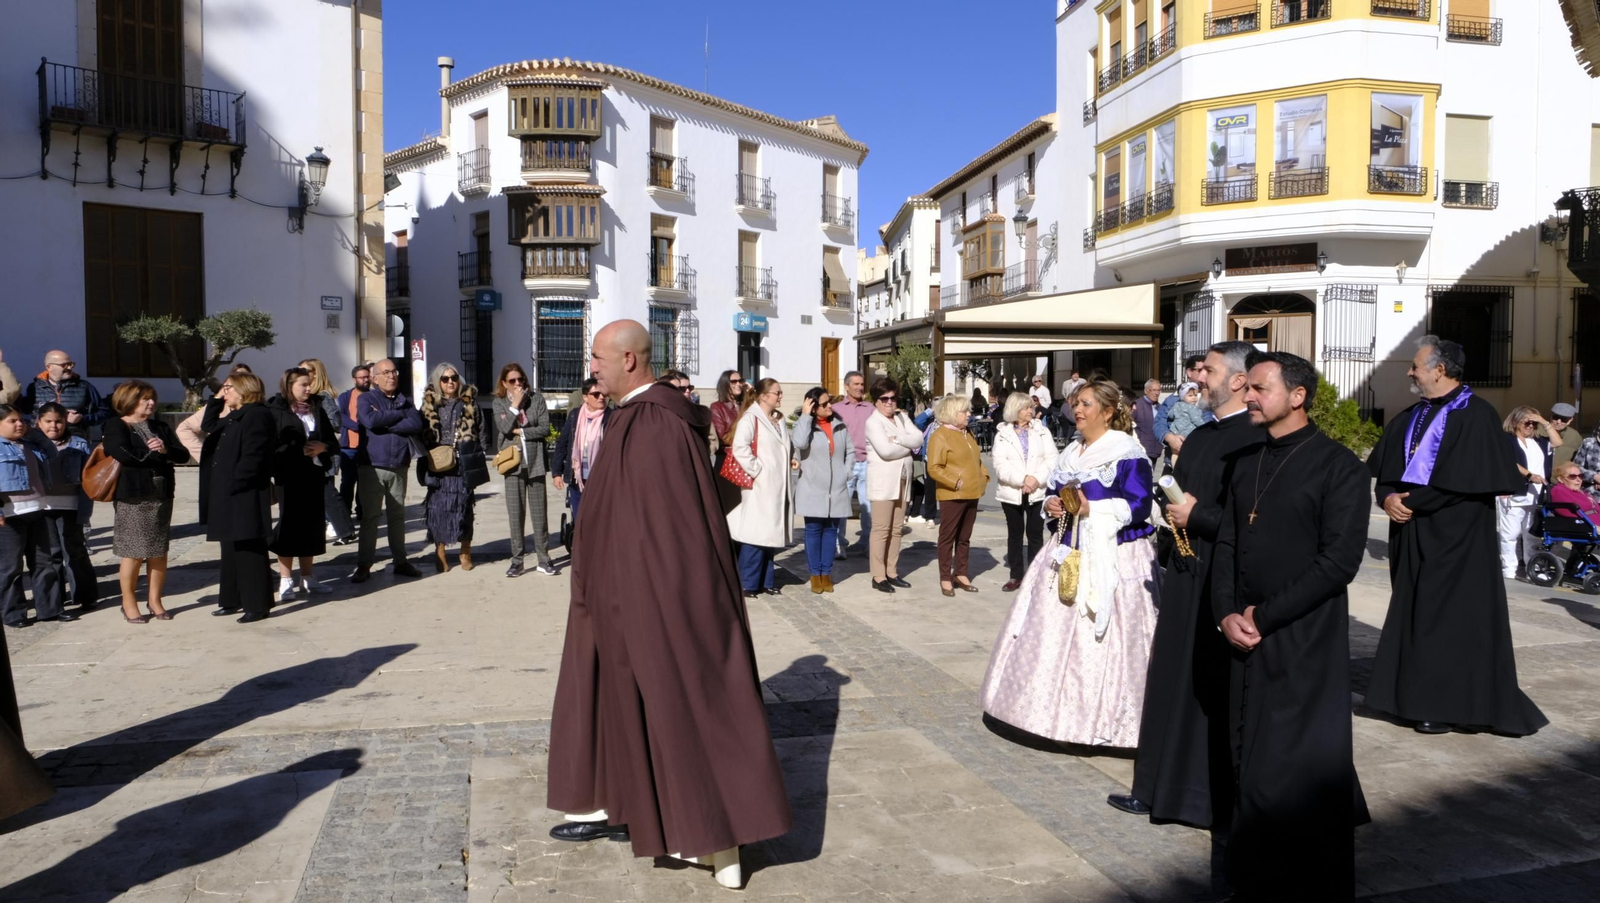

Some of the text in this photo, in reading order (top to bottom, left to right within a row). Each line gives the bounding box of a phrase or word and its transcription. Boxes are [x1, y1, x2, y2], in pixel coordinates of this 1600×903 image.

[1218, 115, 1247, 126] OVR
[1384, 135, 1392, 143] La
[1132, 143, 1145, 154] OVR
[1242, 246, 1298, 259] MARTOS
